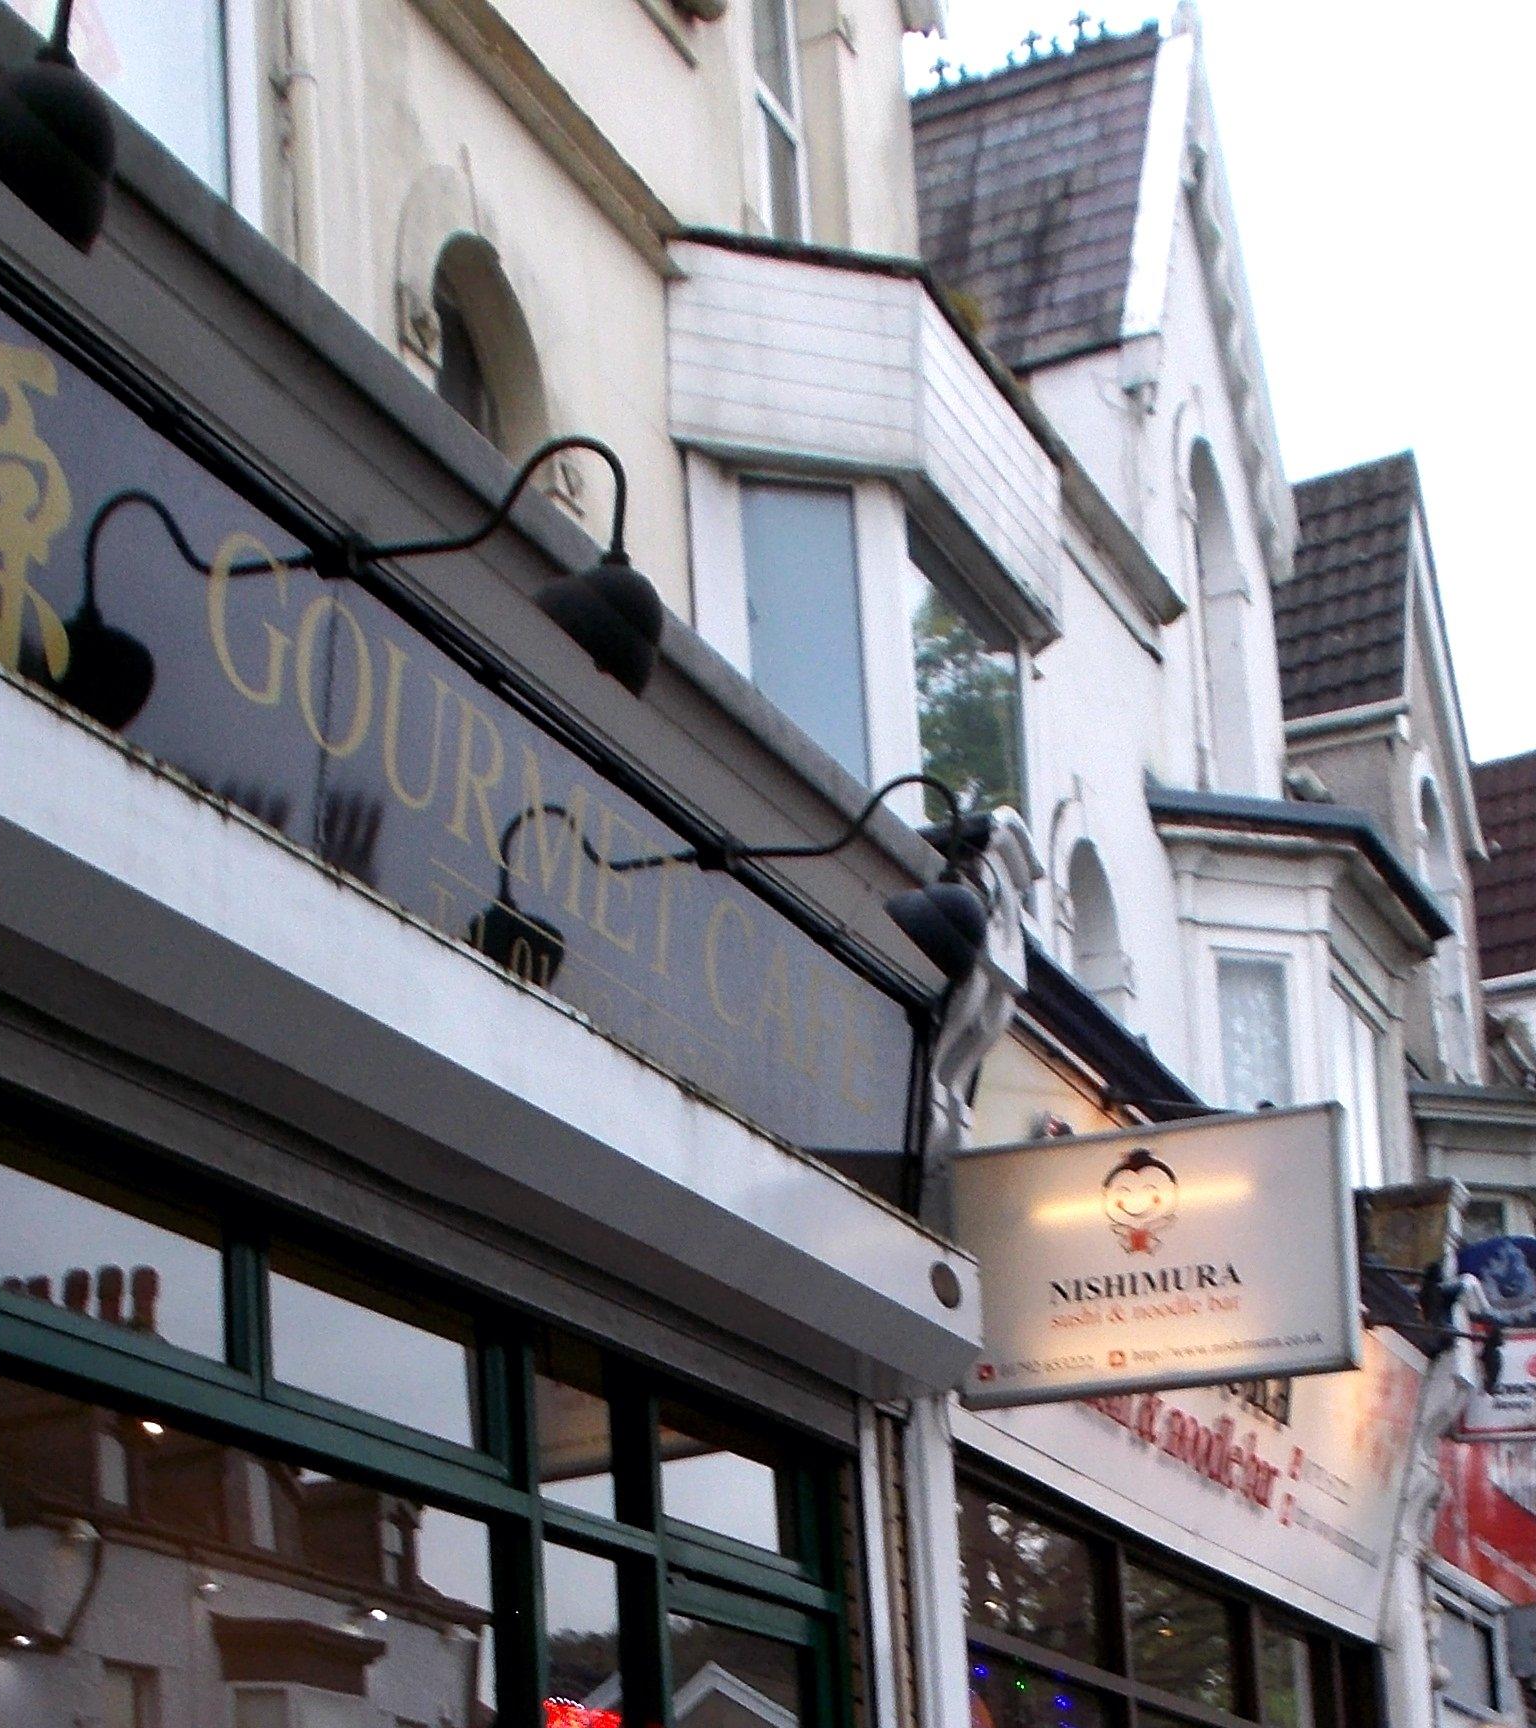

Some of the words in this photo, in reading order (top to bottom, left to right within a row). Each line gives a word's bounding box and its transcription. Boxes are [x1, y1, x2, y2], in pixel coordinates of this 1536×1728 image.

[207, 530, 696, 978] GOURMET
[703, 898, 882, 1116] CAFE
[1049, 1262, 1243, 1303] NISHIMURA
[1208, 1294, 1241, 1314] bar
